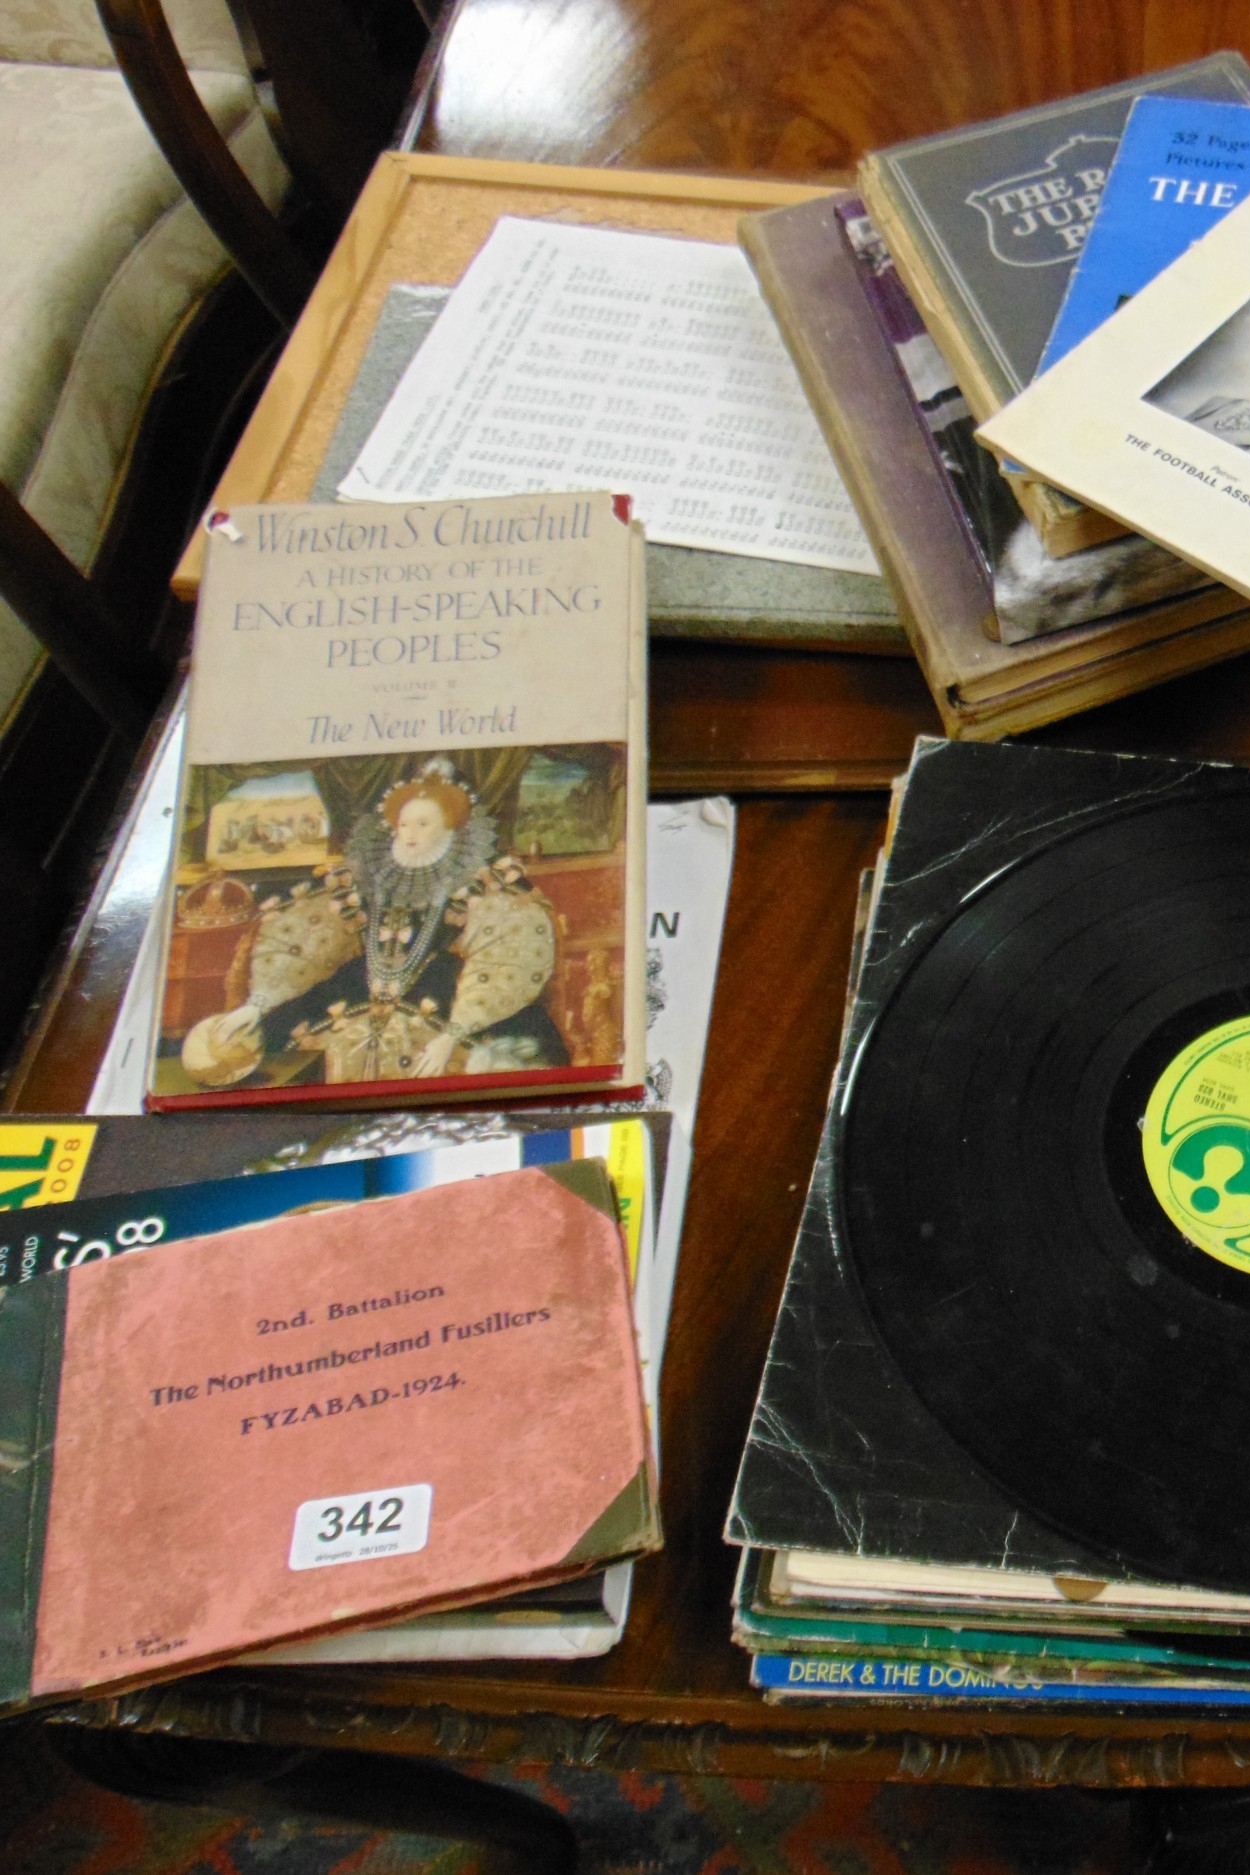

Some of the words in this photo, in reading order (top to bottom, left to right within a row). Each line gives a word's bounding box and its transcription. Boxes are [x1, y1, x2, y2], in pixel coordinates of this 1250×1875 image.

[1171, 130, 1200, 146] 32
[1165, 151, 1245, 171] Pictures
[988, 177, 1073, 215] THE
[1075, 168, 1106, 191] R
[1150, 177, 1237, 209] THE
[1013, 194, 1101, 236] JUB
[1124, 434, 1151, 452] THE
[1153, 448, 1218, 488] FOOTBALL
[258, 511, 388, 554] Winston
[433, 502, 592, 547] Churchill
[296, 569, 316, 588] A
[327, 563, 431, 587] HISTORY
[448, 560, 486, 579] OF
[490, 556, 543, 578] THE
[233, 584, 602, 631] ENGLISH-SPEAKING
[326, 631, 502, 668] PEOPLES
[371, 679, 438, 694] VOLUME
[307, 716, 352, 744] The
[362, 713, 427, 742] New
[438, 705, 518, 736] World
[650, 912, 680, 938] N
[1194, 1094, 1226, 1112] STEREO
[19, 1236, 39, 1284] WORLD
[256, 1310, 316, 1336] 2nd.
[327, 1285, 446, 1320] Battalion
[150, 1385, 200, 1407] The
[206, 1330, 431, 1396] Northumberland
[441, 1306, 552, 1343] Fusiliers
[240, 1372, 467, 1435] FYZABAD-1924.
[317, 1497, 404, 1543] 342
[788, 1661, 854, 1684] DEREK
[860, 1665, 876, 1685] &
[882, 1663, 922, 1687] THE
